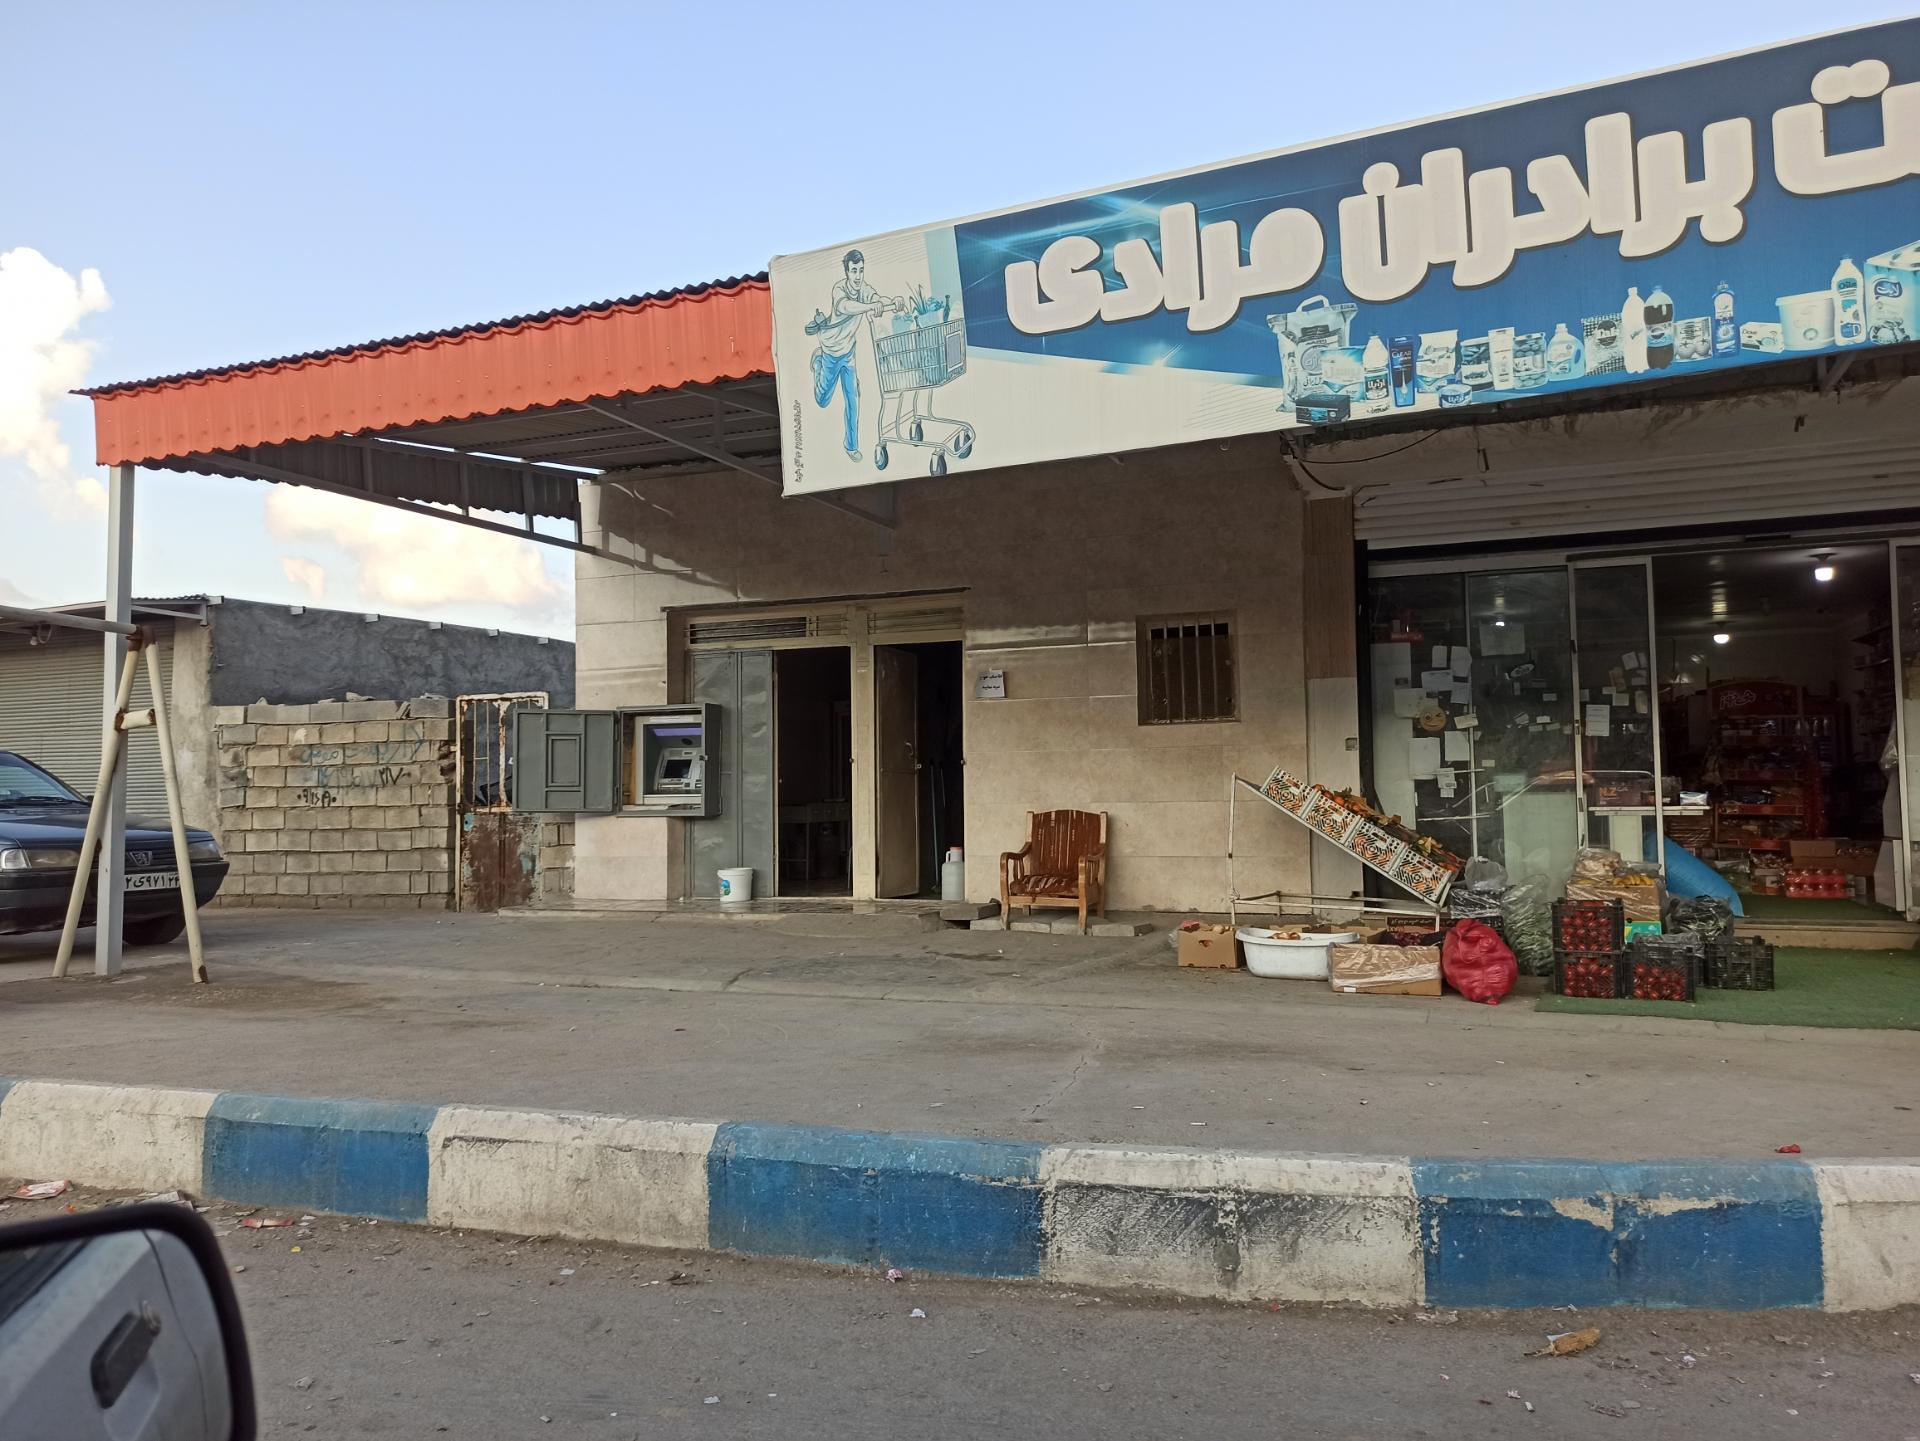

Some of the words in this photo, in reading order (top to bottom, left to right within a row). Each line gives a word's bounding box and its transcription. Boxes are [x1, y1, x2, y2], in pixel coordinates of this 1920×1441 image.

[1005, 202, 1326, 334] مرادی
[1339, 112, 1755, 301] برادران
[1391, 350, 1413, 359] CLEAR
